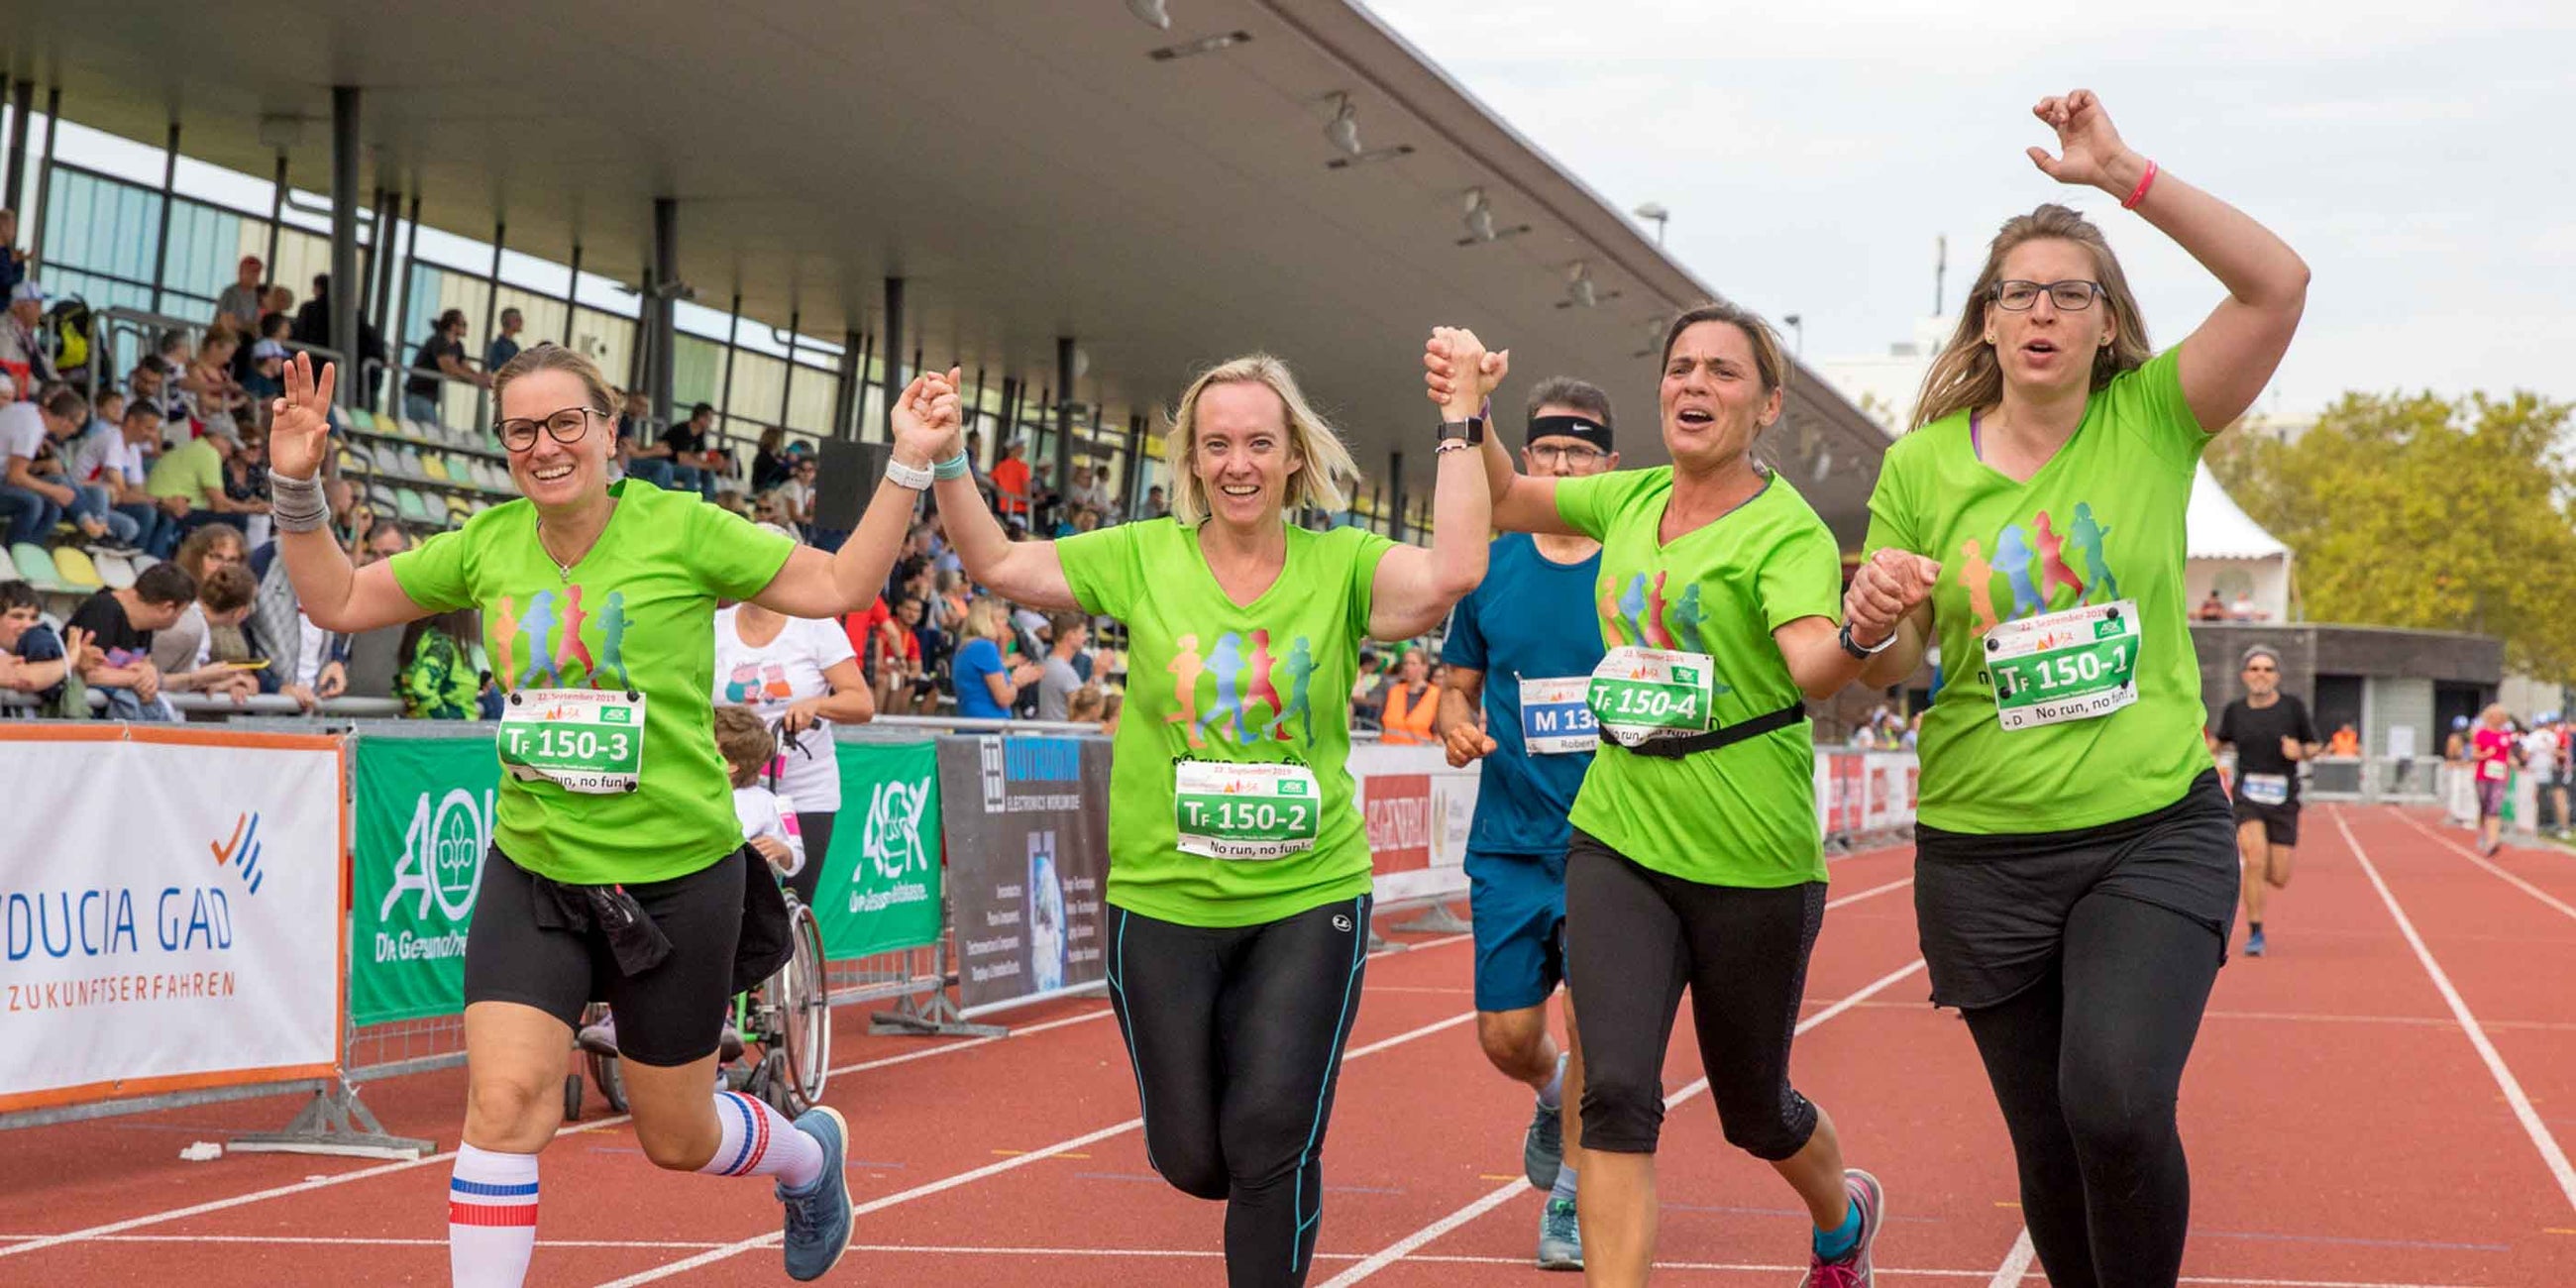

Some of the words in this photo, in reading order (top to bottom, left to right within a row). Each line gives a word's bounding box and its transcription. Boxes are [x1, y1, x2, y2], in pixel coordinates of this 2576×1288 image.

[2036, 646, 2127, 690] 150-1
[1617, 688, 1697, 719] 150-4
[2036, 707, 2056, 719] No
[2060, 703, 2089, 717] run,
[2093, 698, 2110, 708] no
[1536, 710, 1556, 731] M
[538, 730, 628, 761] 150-3
[1561, 739, 1595, 749] Robert
[581, 778, 596, 788] no
[601, 776, 627, 789] fun!
[1218, 803, 1306, 830] 150-2
[1211, 840, 1227, 853] No
[1231, 845, 1256, 856] run,
[1260, 846, 1276, 855] no
[0, 889, 138, 961] DUCIA
[159, 887, 232, 952] GAD
[8, 970, 235, 1013] ZUKUNFTSERFAHREN
